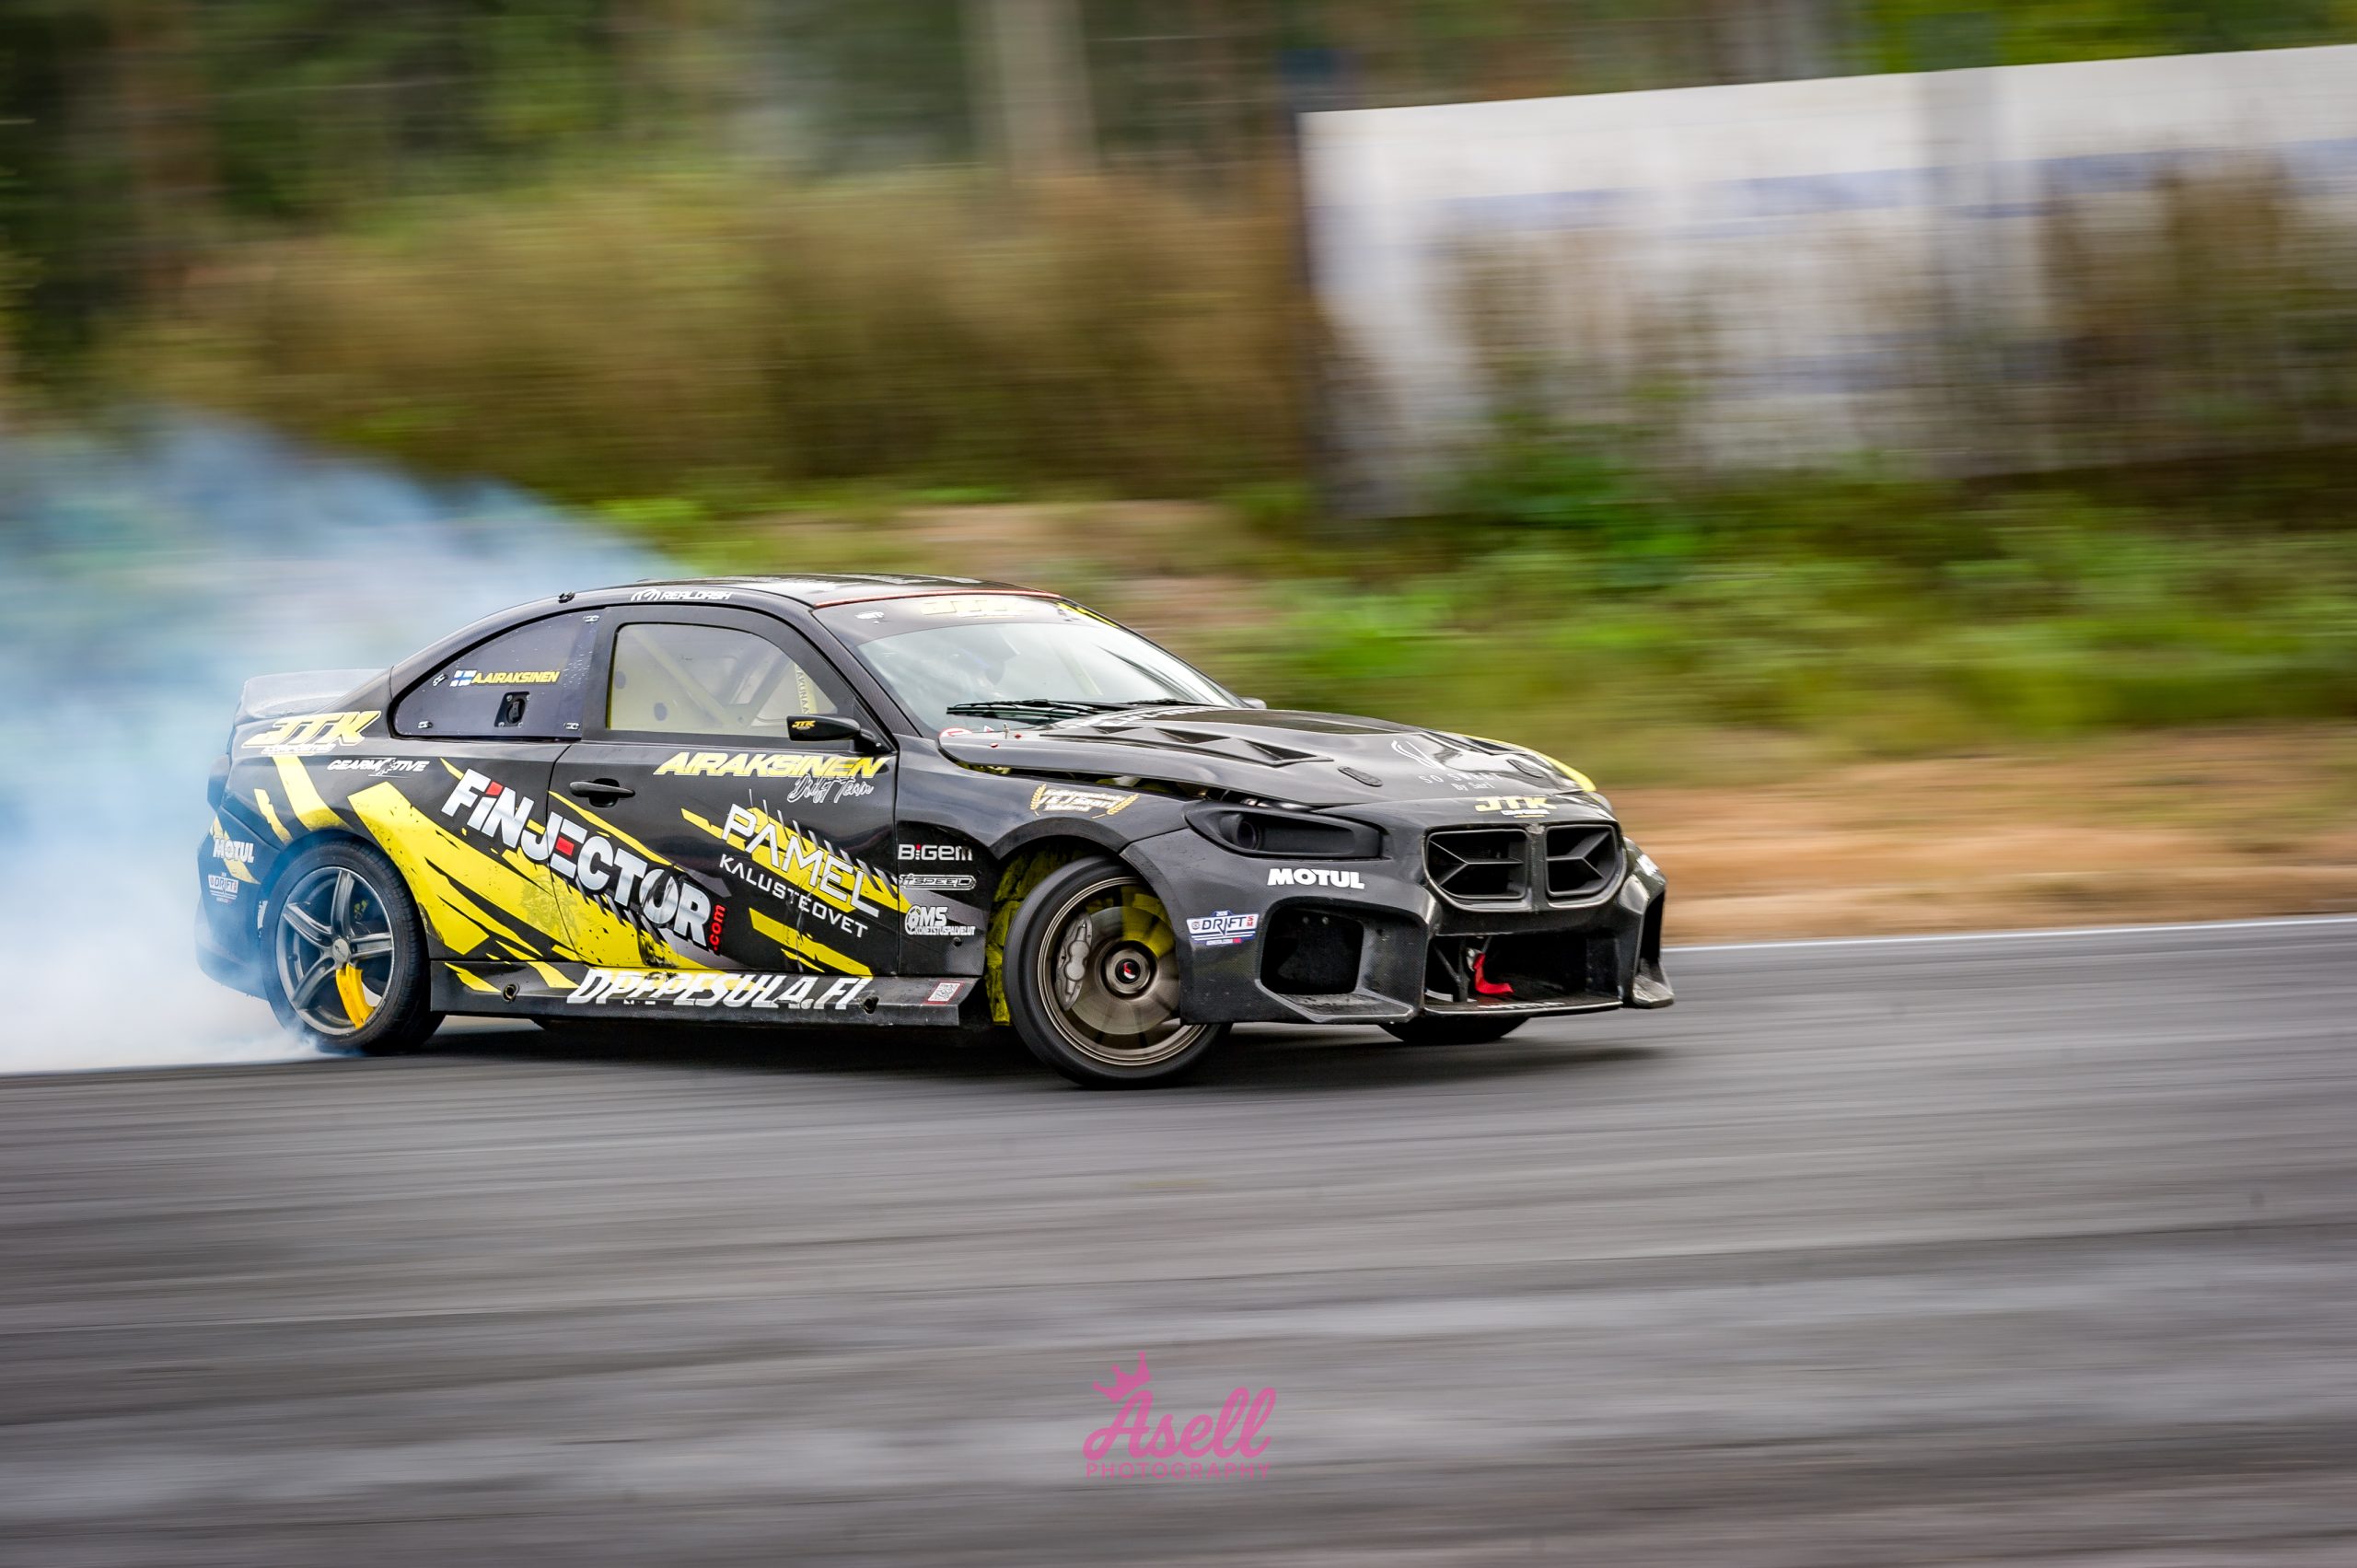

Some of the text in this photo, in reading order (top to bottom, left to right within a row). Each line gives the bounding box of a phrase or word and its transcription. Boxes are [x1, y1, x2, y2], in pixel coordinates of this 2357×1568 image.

[242, 711, 381, 749] JTK
[653, 751, 888, 778] AIRAKSINEN
[1474, 796, 1558, 812] JTK
[213, 839, 255, 864] MOTUL
[721, 803, 880, 918] PAMEL
[1267, 868, 1365, 889] MOTUL
[719, 853, 869, 938] KALUSTEOVET
[1202, 916, 1247, 935] DRIFT
